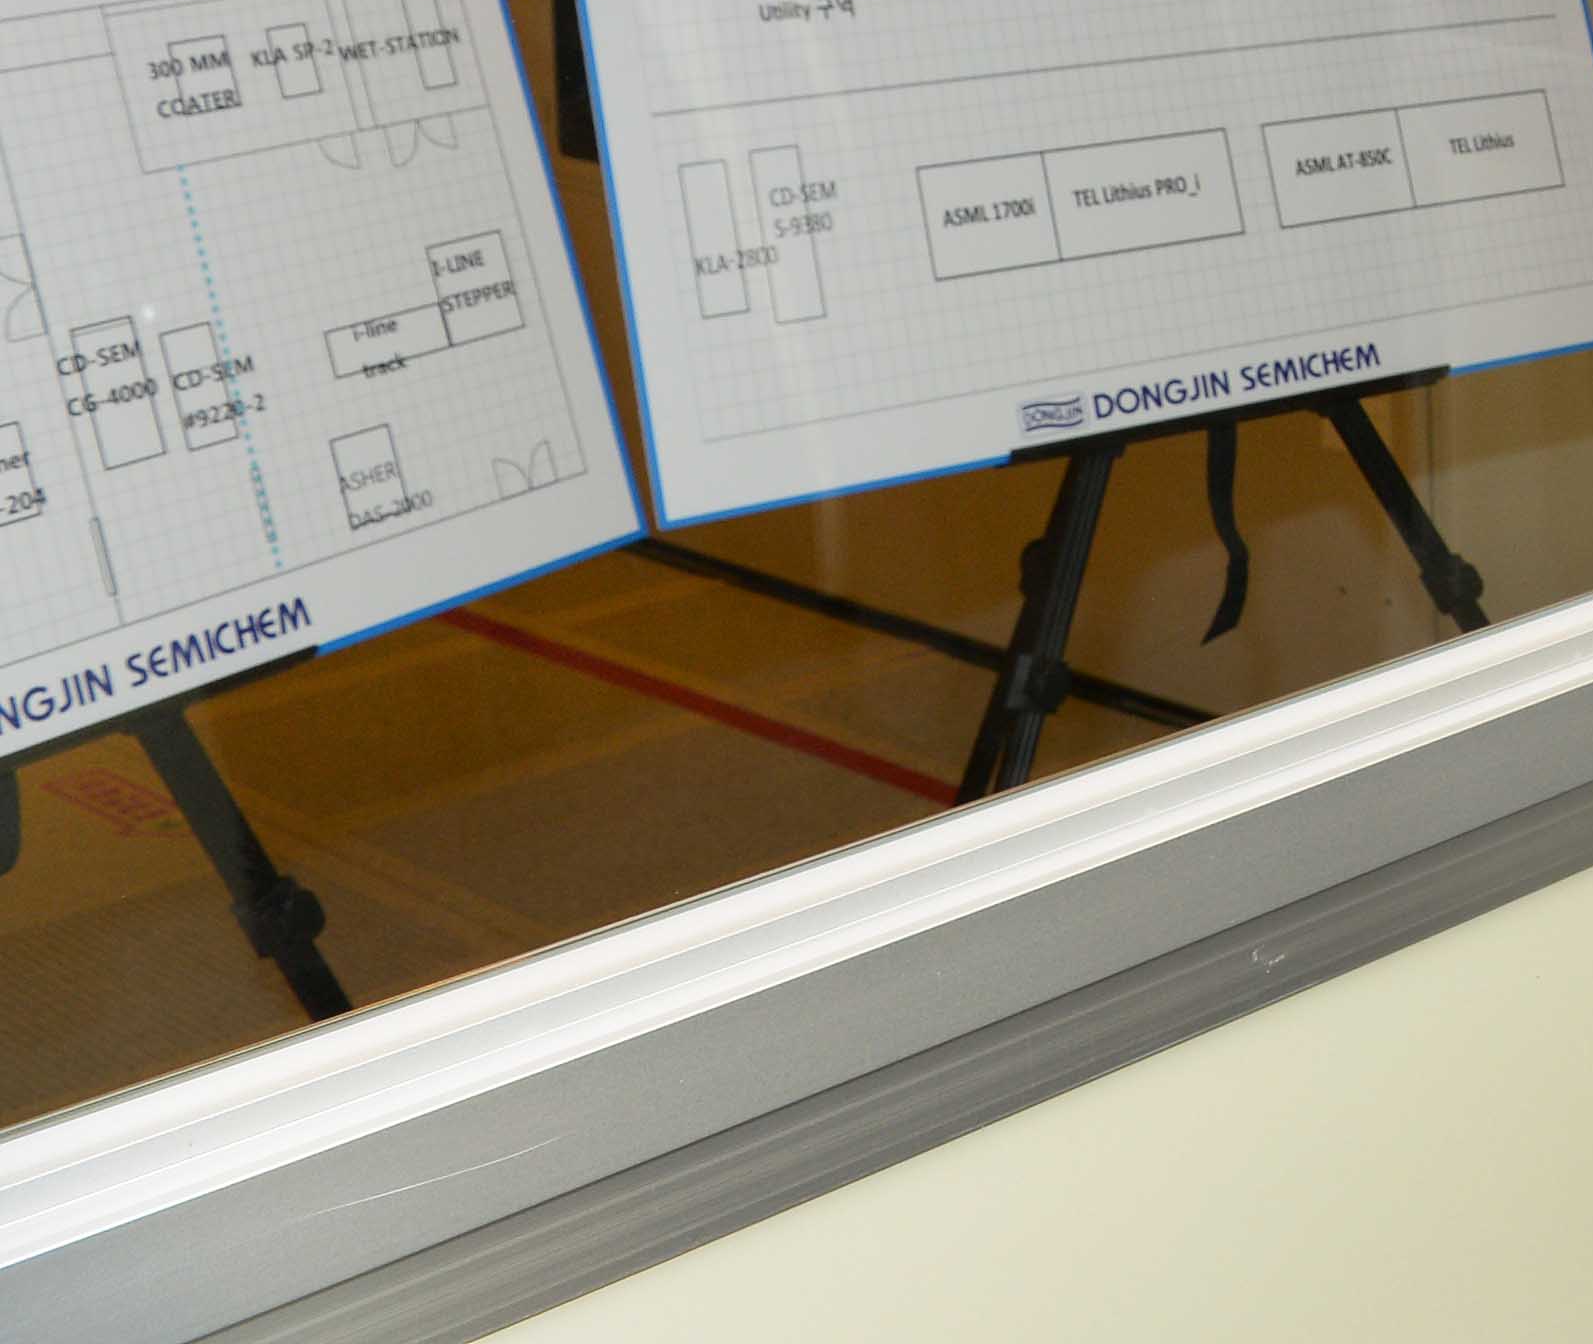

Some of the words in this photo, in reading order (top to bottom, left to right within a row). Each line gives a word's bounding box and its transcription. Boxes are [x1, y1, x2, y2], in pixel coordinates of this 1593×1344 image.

[147, 58, 183, 80] 300
[189, 50, 231, 72] MM
[250, 47, 288, 68] KLA
[156, 88, 236, 118] COATER
[1449, 136, 1472, 156] TEL
[767, 180, 837, 207] CD-SEM
[1072, 188, 1101, 208] TEL
[439, 279, 518, 315] STEPPER
[56, 340, 143, 376] CD-SEM
[172, 354, 255, 392] CD-SEM
[66, 377, 159, 417] CG-4000
[1093, 369, 1231, 420] DONGJIN
[1240, 342, 1380, 391] SEMICHEM
[126, 596, 313, 688] SEMICHEM
